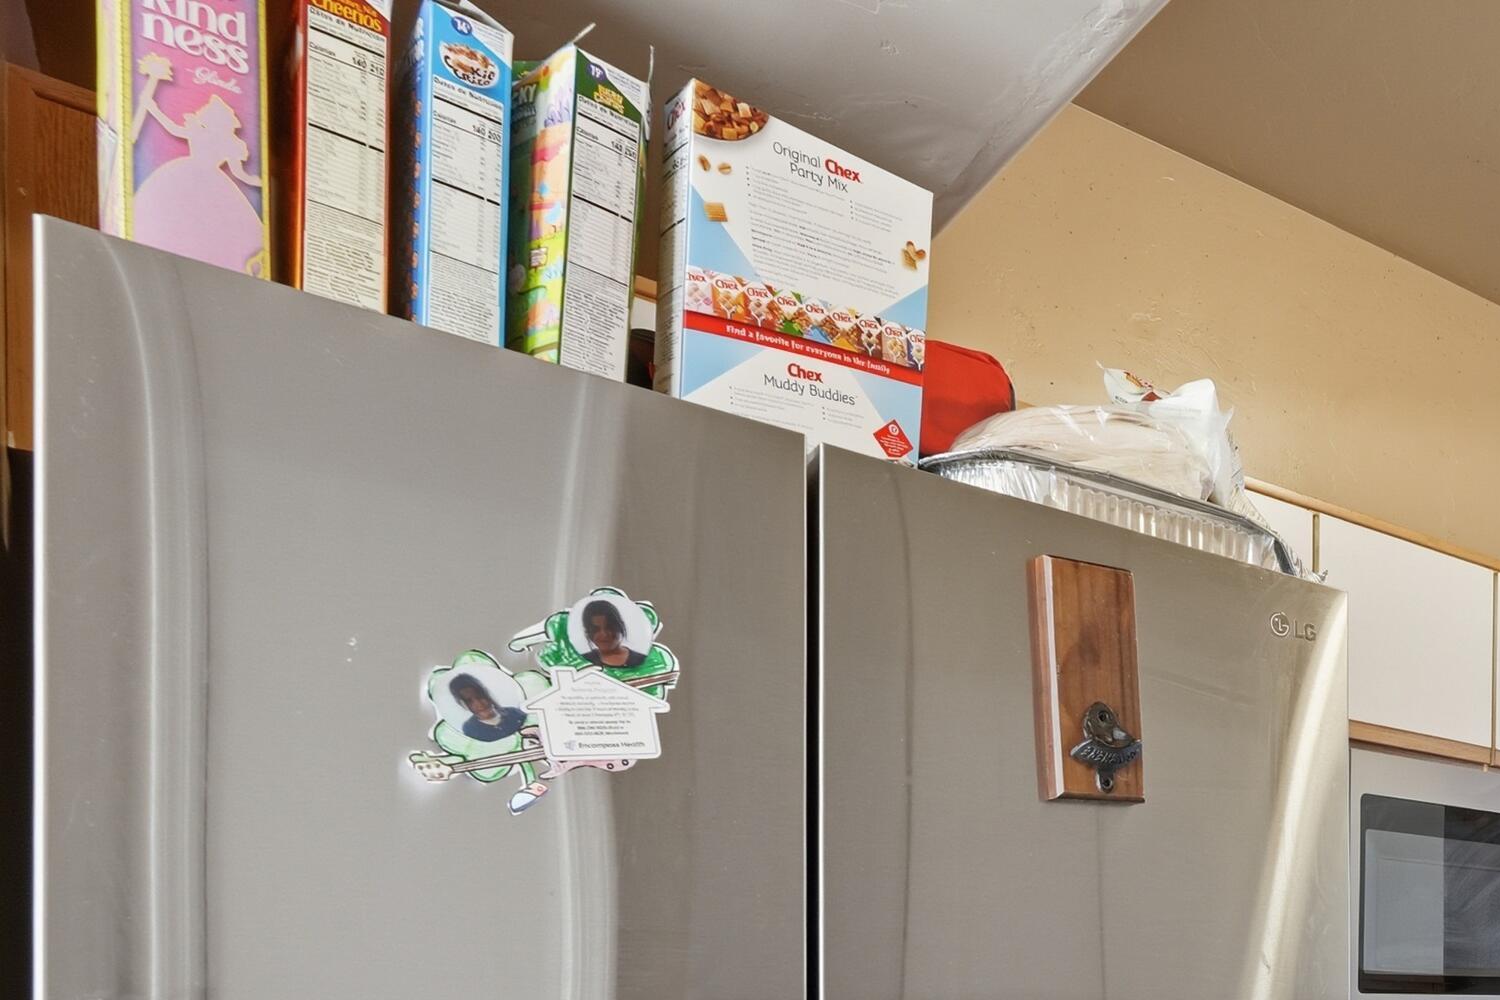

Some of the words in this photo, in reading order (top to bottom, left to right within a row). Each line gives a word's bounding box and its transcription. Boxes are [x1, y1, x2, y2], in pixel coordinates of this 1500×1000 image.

[141, 12, 249, 74] ness
[773, 141, 821, 168] Original
[825, 158, 862, 183] Chex
[790, 162, 824, 187] Party
[828, 176, 849, 193] Mix
[687, 272, 705, 282] hex
[715, 279, 739, 290] Chex
[746, 287, 769, 298] Chex
[777, 296, 797, 307] Chex
[805, 303, 825, 315] Chex
[832, 312, 853, 323] Chex
[859, 319, 879, 330] Chex
[884, 326, 903, 337] Chex
[726, 325, 746, 337] Find
[756, 330, 790, 348] favorite
[791, 340, 804, 351] for
[806, 346, 842, 361] everyone
[787, 362, 824, 384] Chex
[764, 374, 805, 396] Muddy
[809, 384, 856, 406] Buddies
